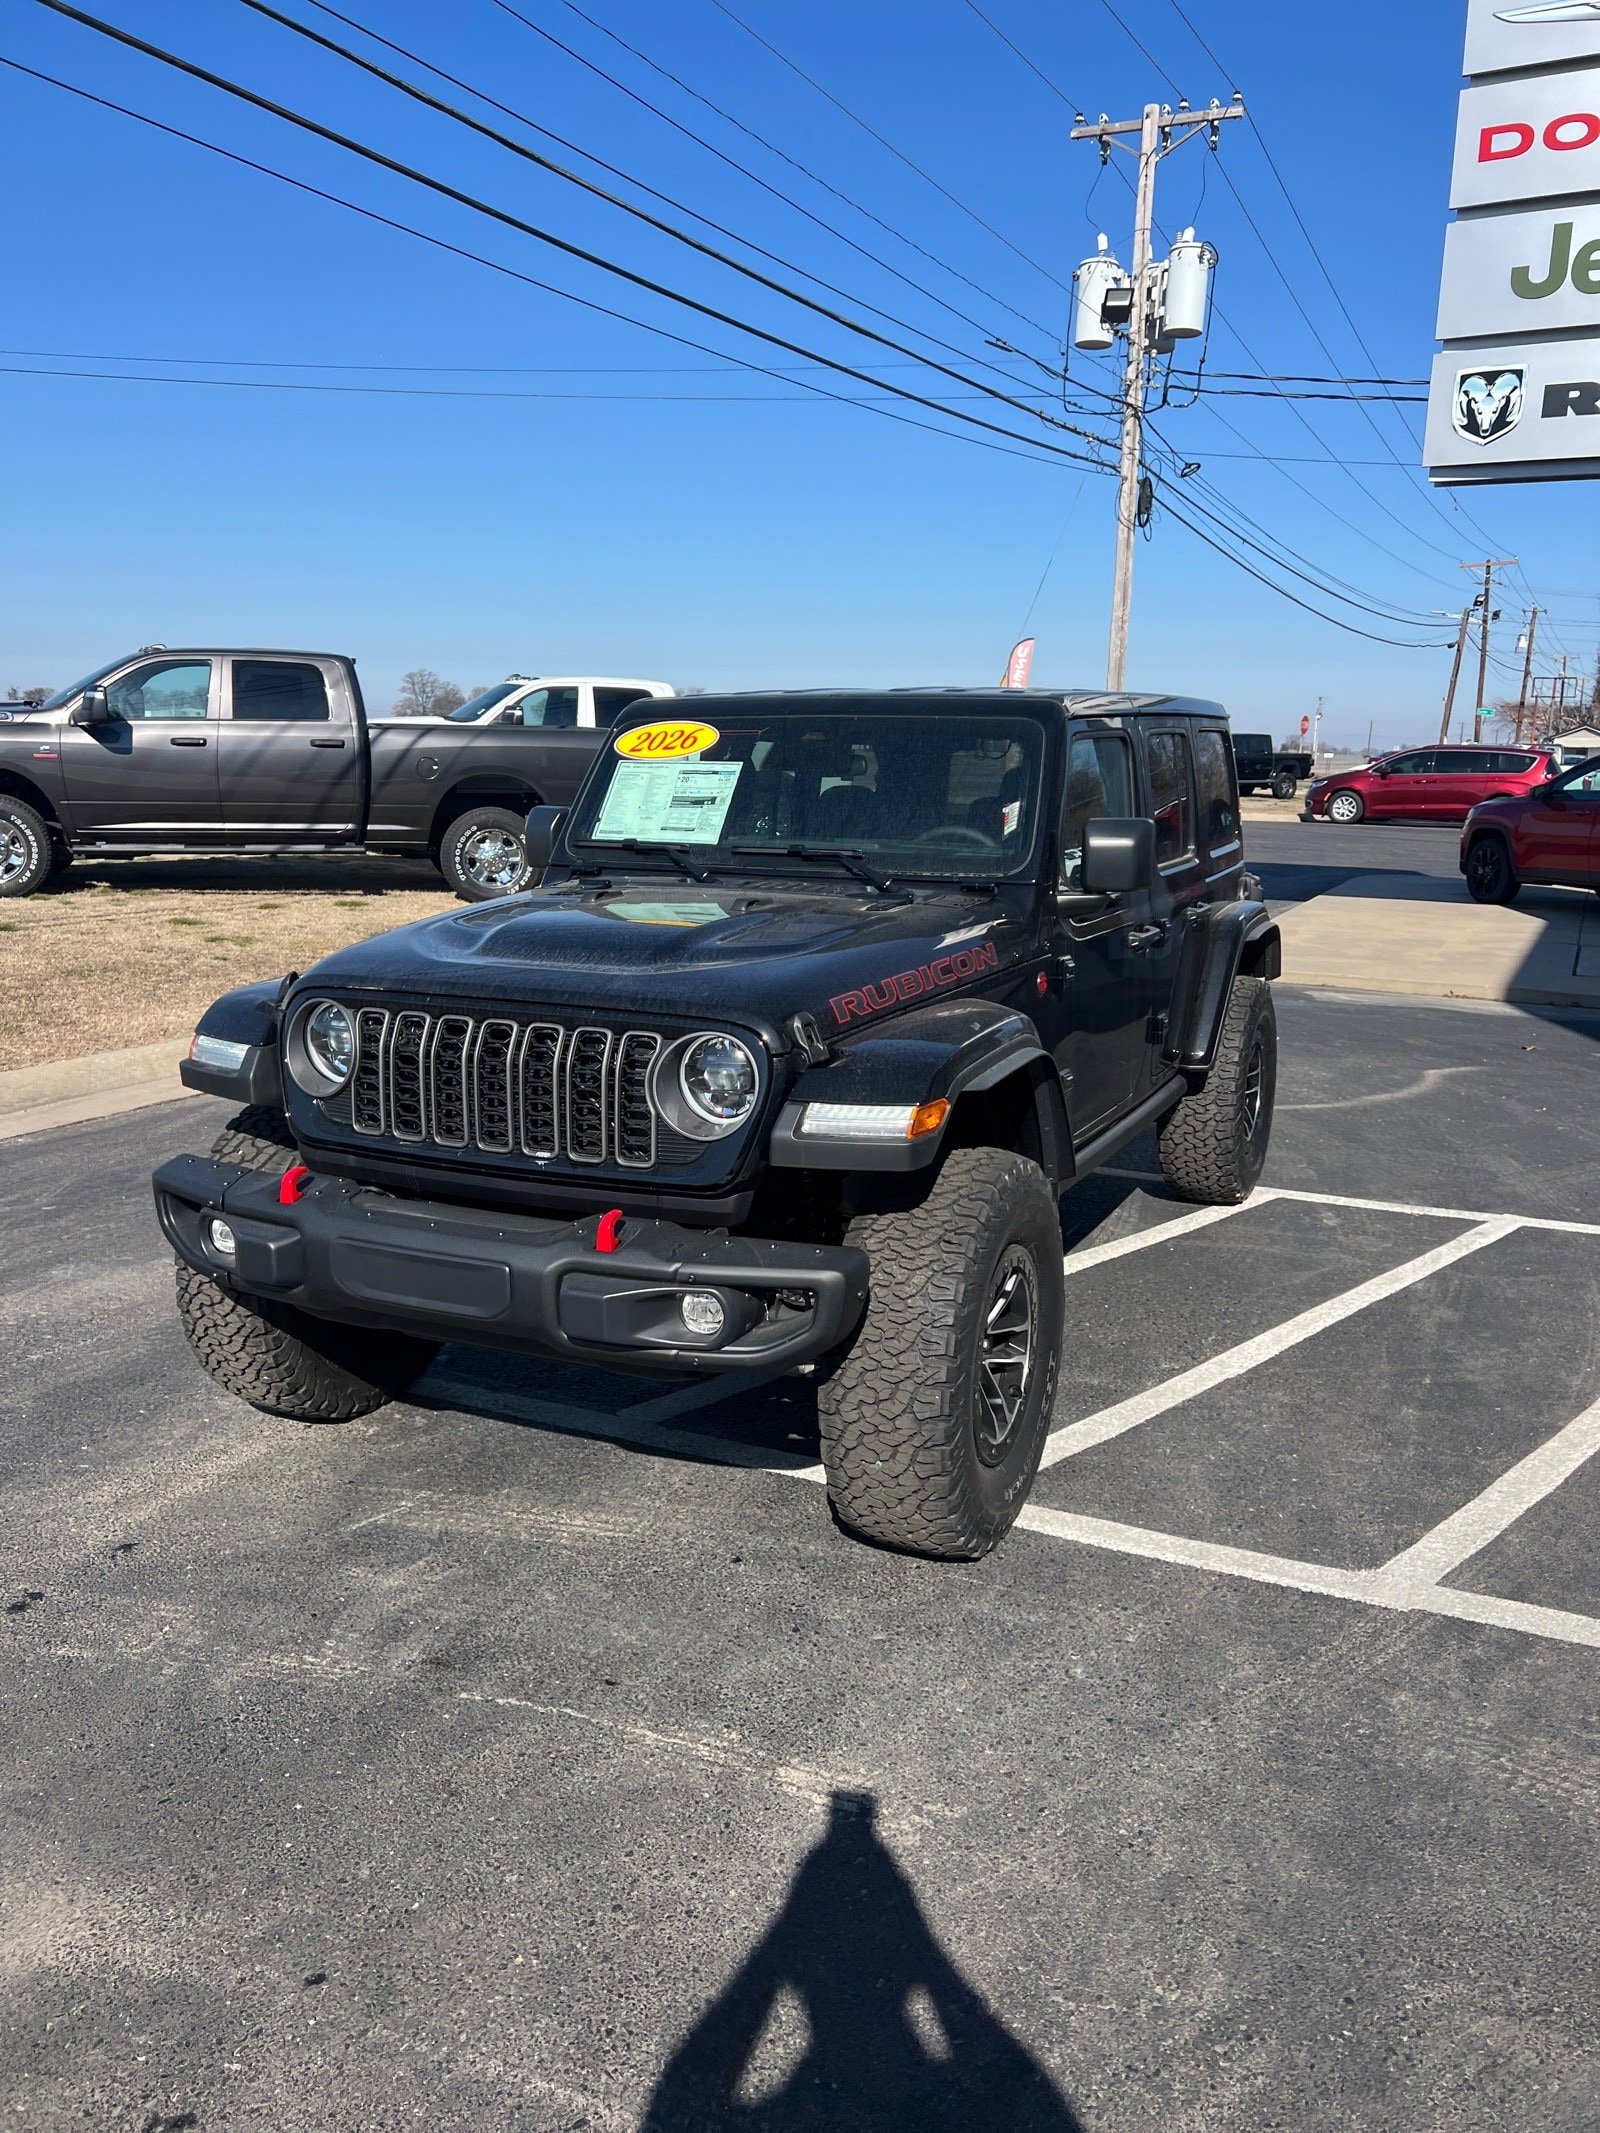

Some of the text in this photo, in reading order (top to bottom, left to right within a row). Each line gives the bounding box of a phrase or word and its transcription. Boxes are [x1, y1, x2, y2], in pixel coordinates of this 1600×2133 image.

[1478, 113, 1600, 163] DO
[628, 728, 705, 753] 2026
[454, 825, 478, 882] Firestone
[829, 942, 999, 1025] RUBICON
